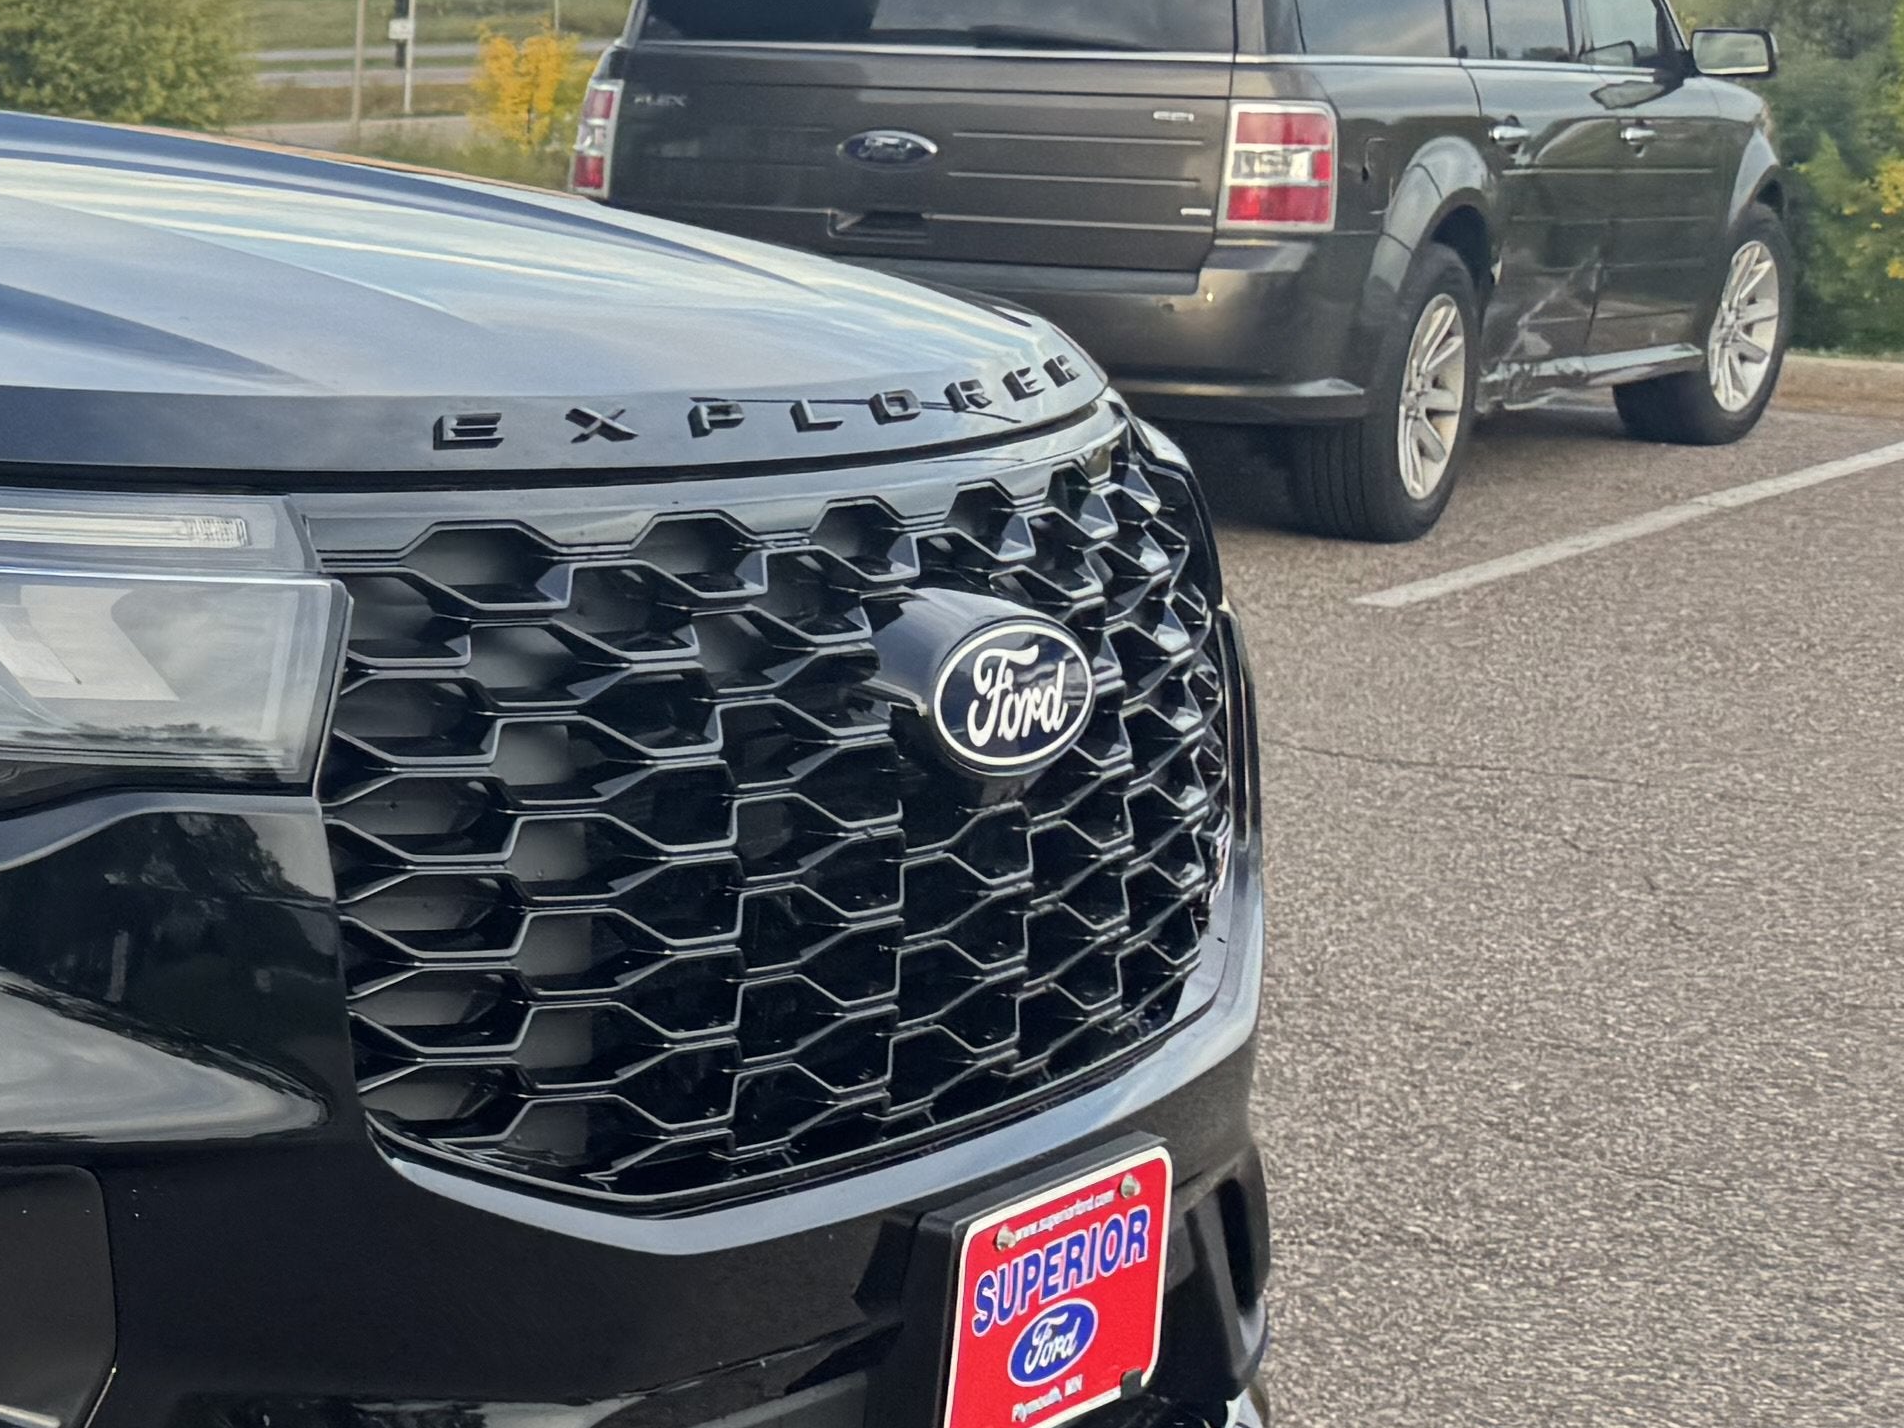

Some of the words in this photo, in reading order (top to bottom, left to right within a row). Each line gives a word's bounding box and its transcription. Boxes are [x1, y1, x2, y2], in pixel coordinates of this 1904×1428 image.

[433, 354, 1080, 451] EXPLORER
[967, 644, 1069, 747] Ford
[972, 1204, 1150, 1337] SUPERIOR
[1023, 1312, 1081, 1374] Ford
